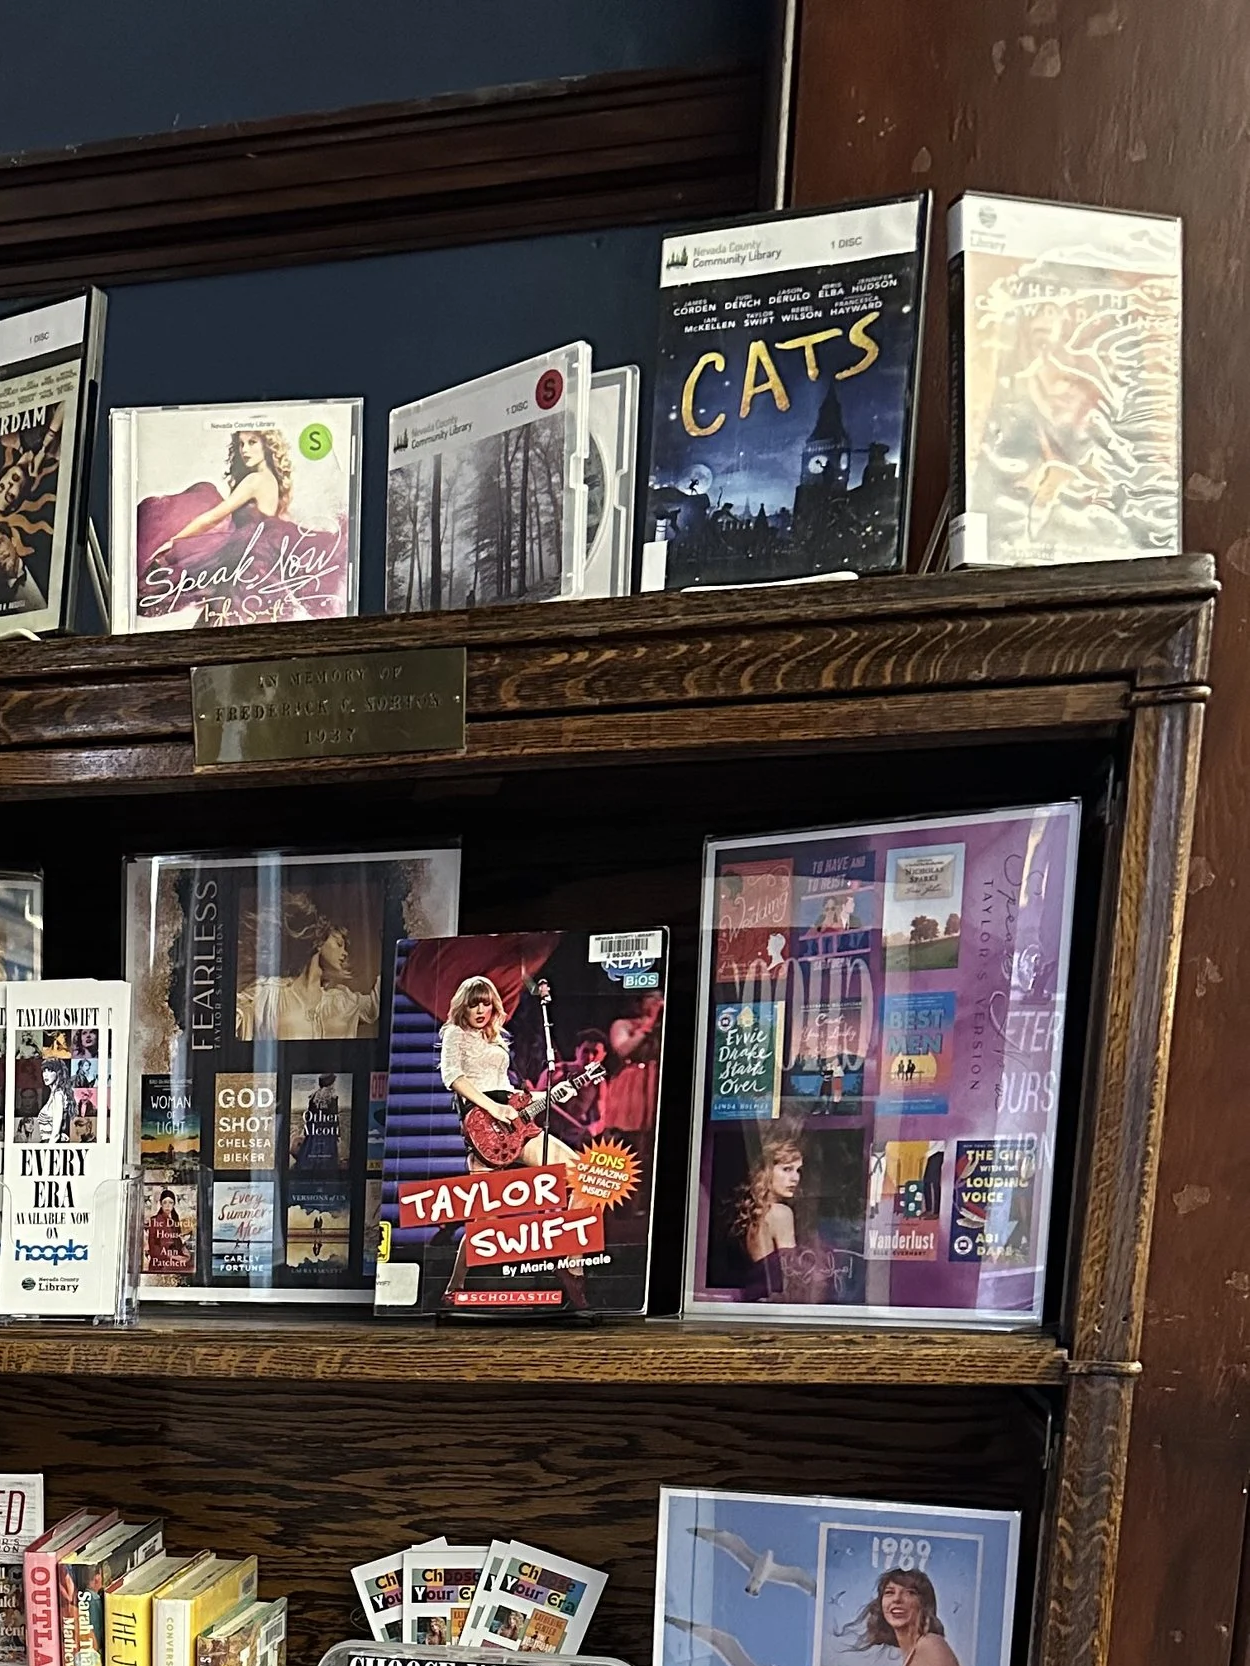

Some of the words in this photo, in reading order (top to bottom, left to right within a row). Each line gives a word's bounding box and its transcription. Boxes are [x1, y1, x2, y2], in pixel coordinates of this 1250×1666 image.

[673, 304, 716, 316] CORDEN
[725, 298, 760, 310] DENCH
[769, 291, 811, 304] DERULO
[818, 288, 844, 298] ELBA
[852, 279, 897, 293] HUDSON
[682, 312, 880, 437] CATS
[542, 378, 556, 401] S
[309, 431, 321, 451] S
[139, 522, 264, 612] Speak
[247, 522, 342, 593] Now
[290, 668, 366, 686] MEMORY
[192, 880, 218, 1052] FEARLESS
[16, 1009, 60, 1027] TAYLOR
[63, 1008, 99, 1027] SWIFT
[889, 1009, 944, 1029] BEST
[888, 1035, 942, 1054] MEN
[218, 1088, 274, 1108] GOD
[219, 1117, 273, 1133] SHOT
[218, 1139, 271, 1147] CHELSEA
[21, 1149, 89, 1176] EVERY
[224, 1154, 265, 1162] BIEKER
[588, 1151, 625, 1169] TONS
[34, 1181, 75, 1208] ERA
[401, 1173, 559, 1221] TAYLOR
[962, 1192, 1003, 1203] VOICE
[471, 1216, 597, 1258] SWIFT
[869, 1229, 933, 1250] Wanderlust
[16, 1240, 88, 1265] hoopla
[503, 1264, 517, 1277] By
[520, 1261, 554, 1274] Marie
[558, 1254, 610, 1269] Morreale
[38, 1283, 79, 1293] Library
[470, 1292, 559, 1302] SCHOLASTIC
[871, 1537, 931, 1572] 1989
[112, 1612, 135, 1644] THE
